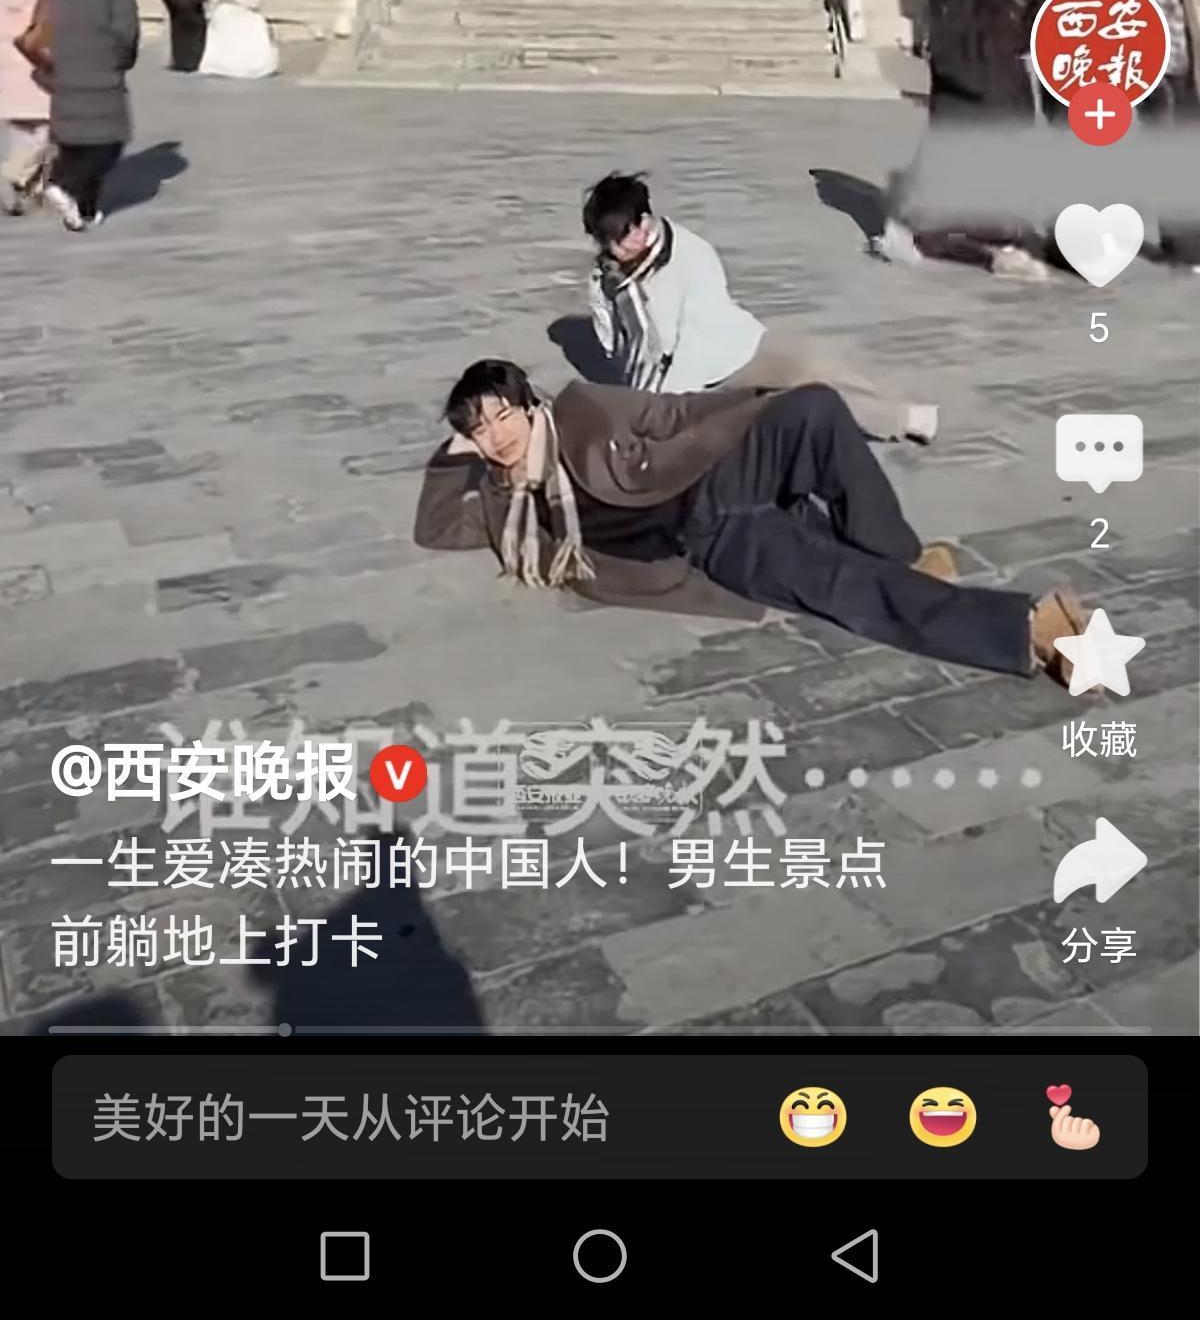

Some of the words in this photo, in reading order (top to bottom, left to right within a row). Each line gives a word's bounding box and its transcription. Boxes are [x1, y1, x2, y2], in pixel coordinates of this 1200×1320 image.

[1088, 311, 1110, 344] 5
[1089, 516, 1110, 549] 2
[1061, 720, 1138, 759] 收藏
[50, 739, 358, 803] @西安晚报
[50, 835, 887, 891] 一生爱凑热闹的中国人！男生景点
[50, 913, 384, 968] 前躺地上打卡
[1061, 926, 1138, 965] 分享
[92, 1091, 611, 1143] 美好的一天从评论开始
